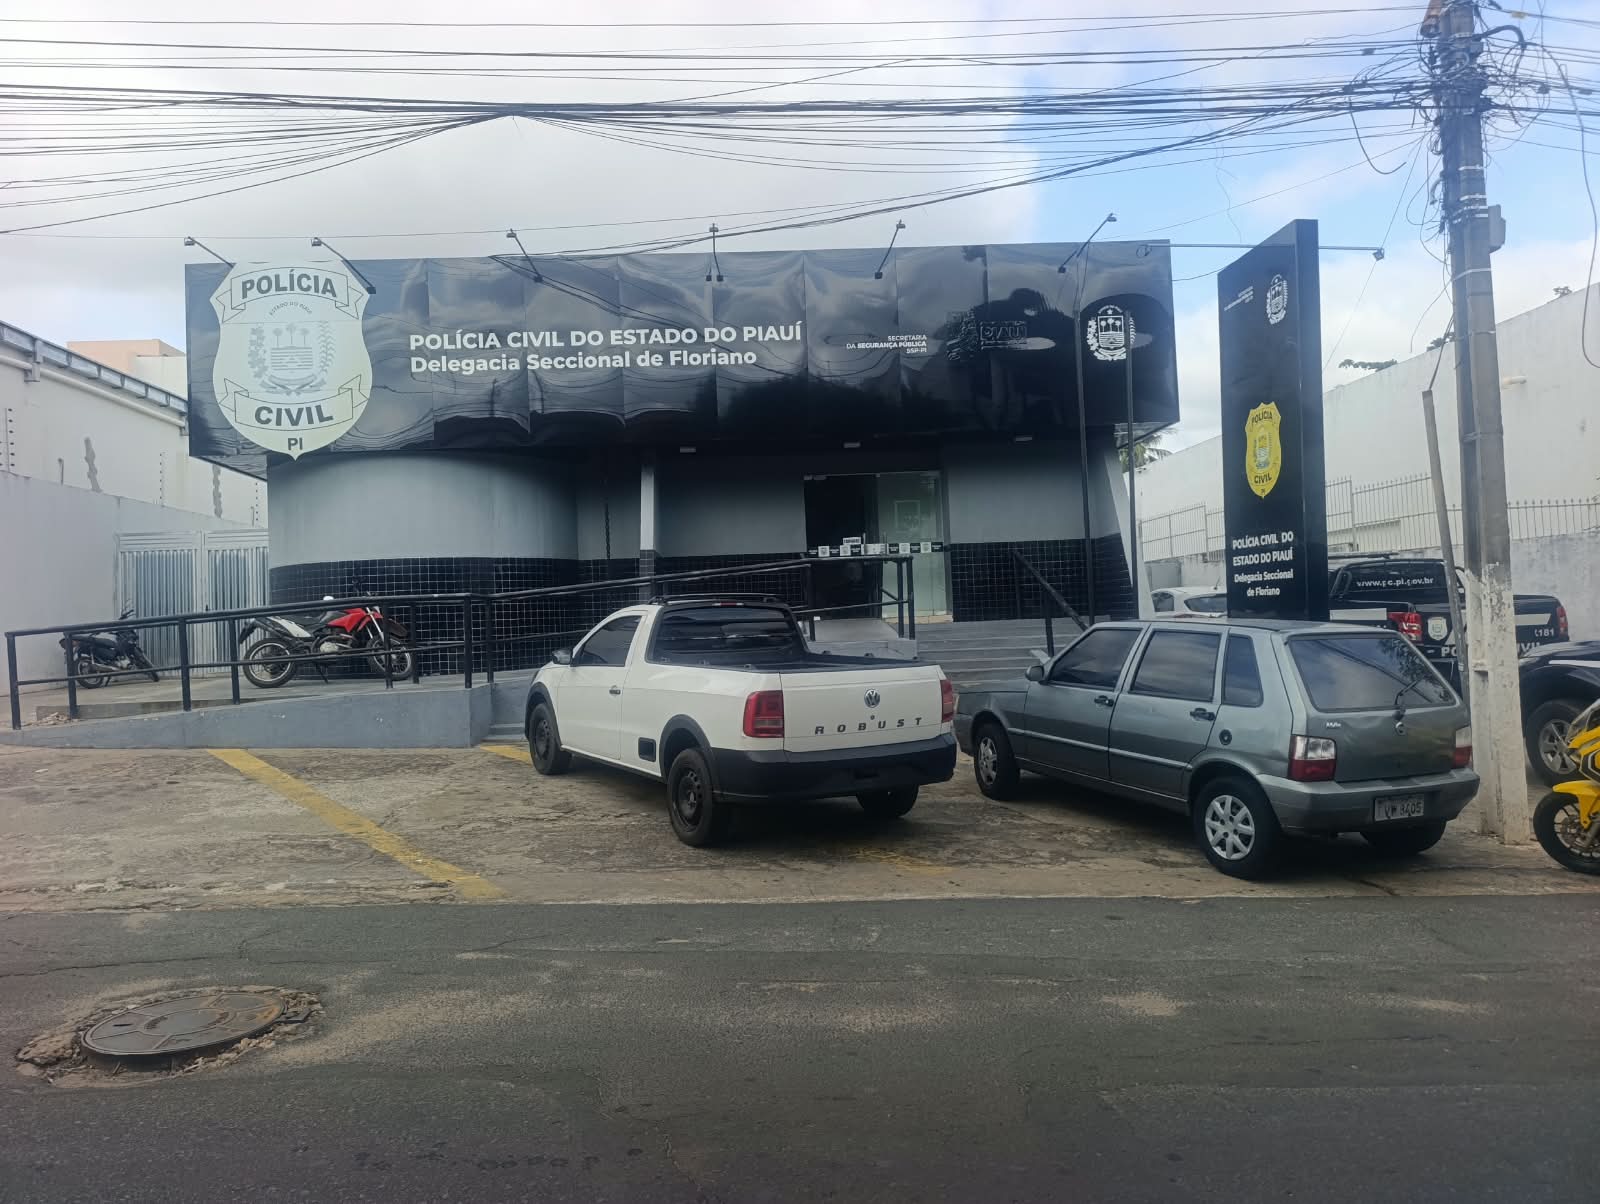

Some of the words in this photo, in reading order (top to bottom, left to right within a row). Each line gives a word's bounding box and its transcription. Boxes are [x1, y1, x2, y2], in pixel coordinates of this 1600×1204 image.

[241, 269, 337, 299] POLÍCIA
[410, 328, 501, 350] POLÍCIA
[507, 331, 564, 348] CIVIL
[570, 330, 604, 346] DO
[610, 327, 698, 346] ESTADO
[704, 326, 737, 344] DO
[744, 320, 802, 342] PIAUÍ
[858, 342, 898, 350] SEGURANÇA
[410, 353, 520, 376] Delegacia
[526, 350, 630, 371] Seccional
[638, 350, 662, 368] de
[670, 348, 757, 366] Floriano
[254, 404, 334, 427] CIVIL
[288, 437, 303, 451] PI
[1254, 472, 1272, 484] CIVIL
[1232, 534, 1260, 550] POLÍCIA
[1260, 534, 1280, 546] CIVIL
[1282, 530, 1294, 543] DO
[1232, 554, 1260, 566] ESTADO
[1260, 552, 1272, 564] DO
[1272, 546, 1293, 562] PIAUÍ
[1234, 572, 1262, 584] Delegacia
[1263, 568, 1294, 580] Seccional
[1246, 587, 1254, 596] de
[1255, 586, 1280, 596] Floriano
[1539, 628, 1554, 636] 181
[814, 716, 922, 735] ROBUST
